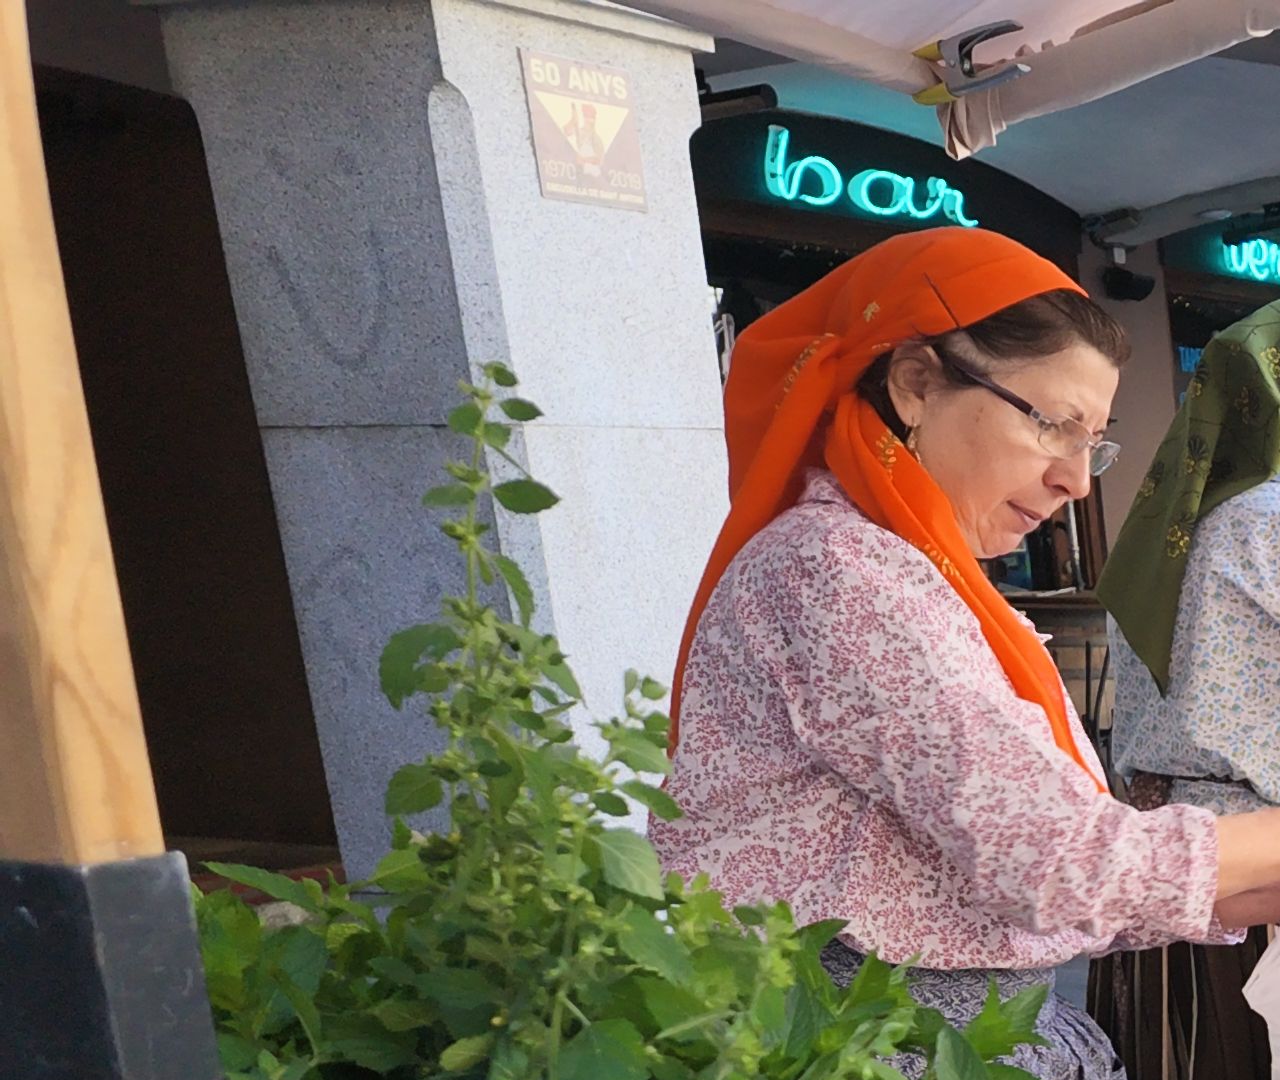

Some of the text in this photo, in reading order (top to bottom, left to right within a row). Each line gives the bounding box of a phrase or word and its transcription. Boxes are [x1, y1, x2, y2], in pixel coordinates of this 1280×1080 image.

[530, 58, 627, 99] 50 ANYS
[542, 160, 642, 190] 1970 2019
[765, 124, 978, 227] bar
